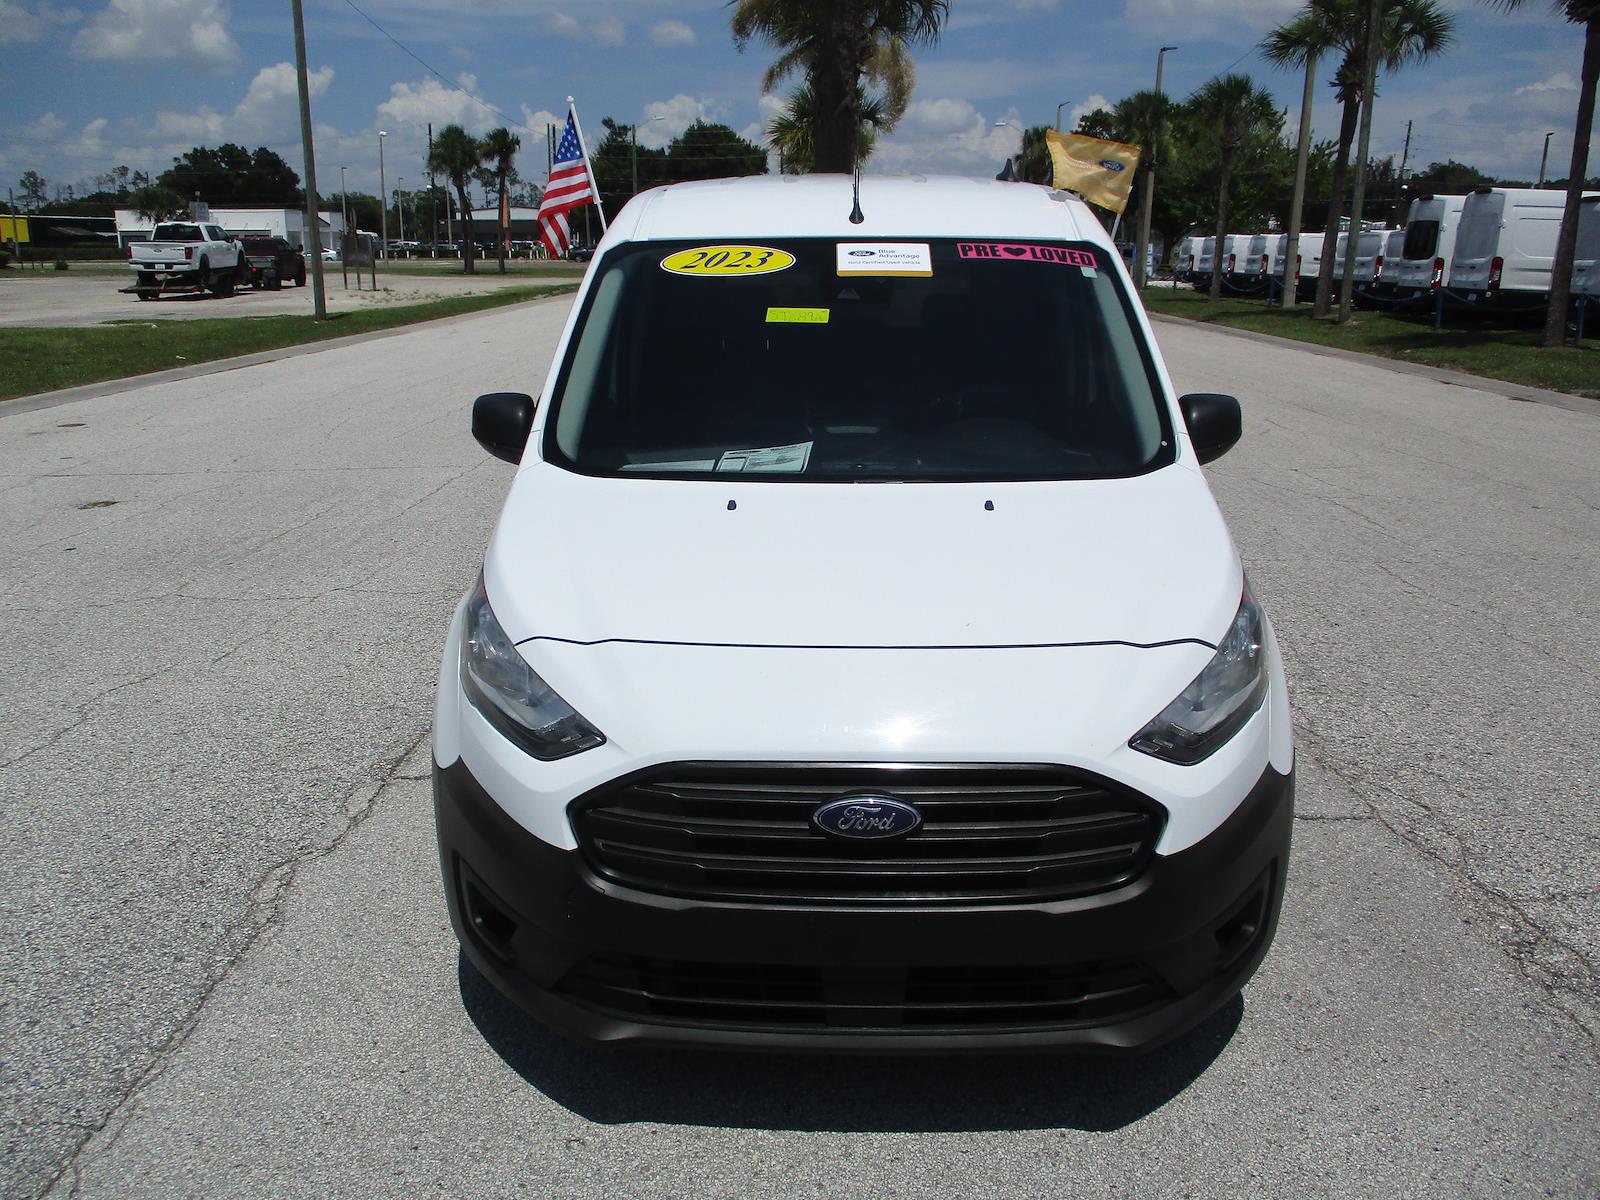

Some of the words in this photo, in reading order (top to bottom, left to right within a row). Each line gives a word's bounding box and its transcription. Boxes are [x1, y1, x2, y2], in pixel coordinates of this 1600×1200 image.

[681, 251, 774, 269] 2023
[960, 244, 1002, 257] PRE
[1030, 247, 1094, 267] LOVED
[838, 805, 895, 830] Ford
